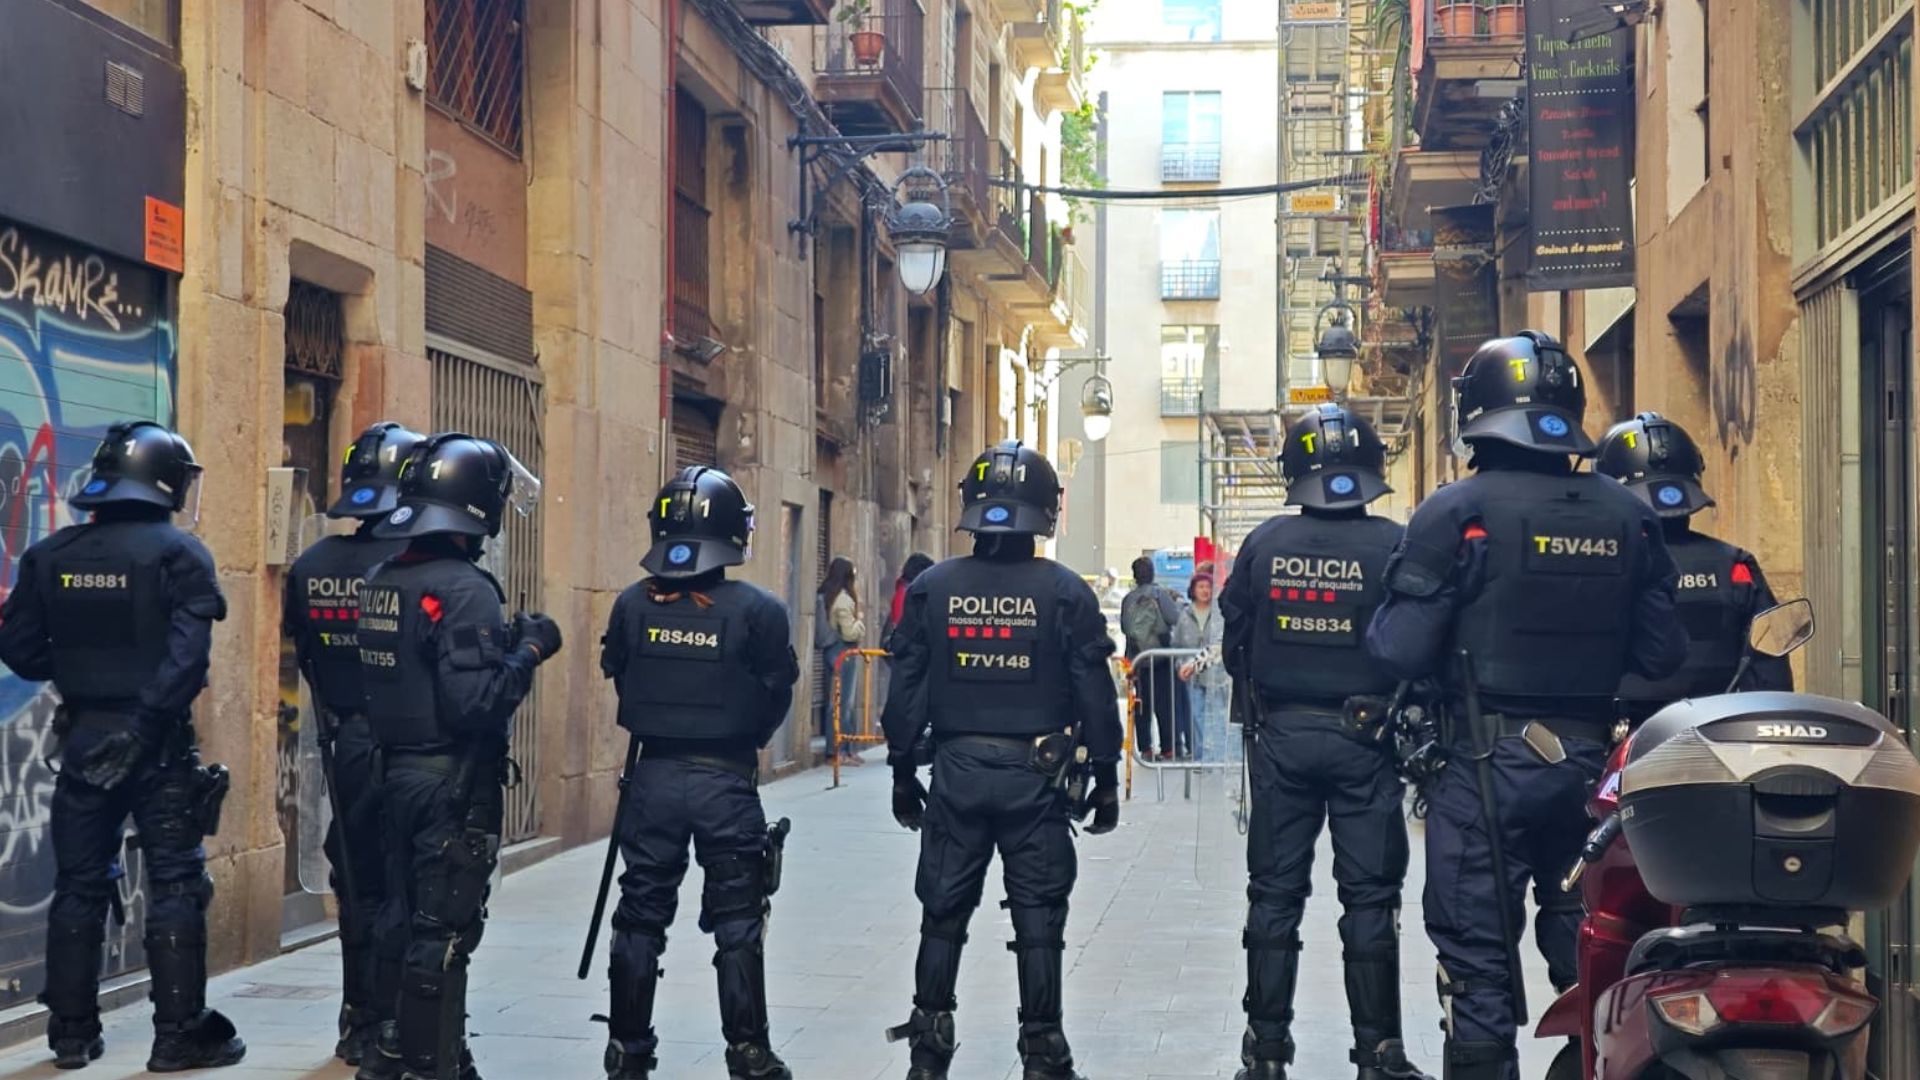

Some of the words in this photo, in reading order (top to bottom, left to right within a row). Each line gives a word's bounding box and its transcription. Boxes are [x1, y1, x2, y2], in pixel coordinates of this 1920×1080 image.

[1535, 34, 1569, 57] Tapas
[1570, 58, 1621, 78] Cocktails
[1509, 358, 1529, 382] T
[1568, 366, 1578, 388] 1
[125, 439, 136, 456] 1
[1301, 432, 1317, 454] T
[1349, 428, 1360, 447] 1
[1623, 432, 1638, 448] T
[386, 445, 397, 462] 1
[430, 459, 443, 480] 1
[976, 462, 990, 481] T
[1016, 465, 1027, 482] 1
[700, 499, 710, 518] 1
[1534, 536, 1618, 556] T5V443
[1271, 557, 1363, 579] POLICIA
[61, 574, 127, 588] T8S881
[308, 577, 366, 597] POLIC
[1271, 578, 1307, 588] mossos
[1310, 579, 1363, 591] d'esquadra
[1678, 573, 1717, 589] 861
[949, 597, 1037, 615] POLICIA
[949, 616, 983, 625] mossos
[985, 615, 1037, 627] d'esquadra
[1277, 615, 1352, 632] T8S834
[648, 628, 718, 647] T8S494
[957, 652, 1030, 669] T7V148
[1758, 724, 1828, 738] SHAD
